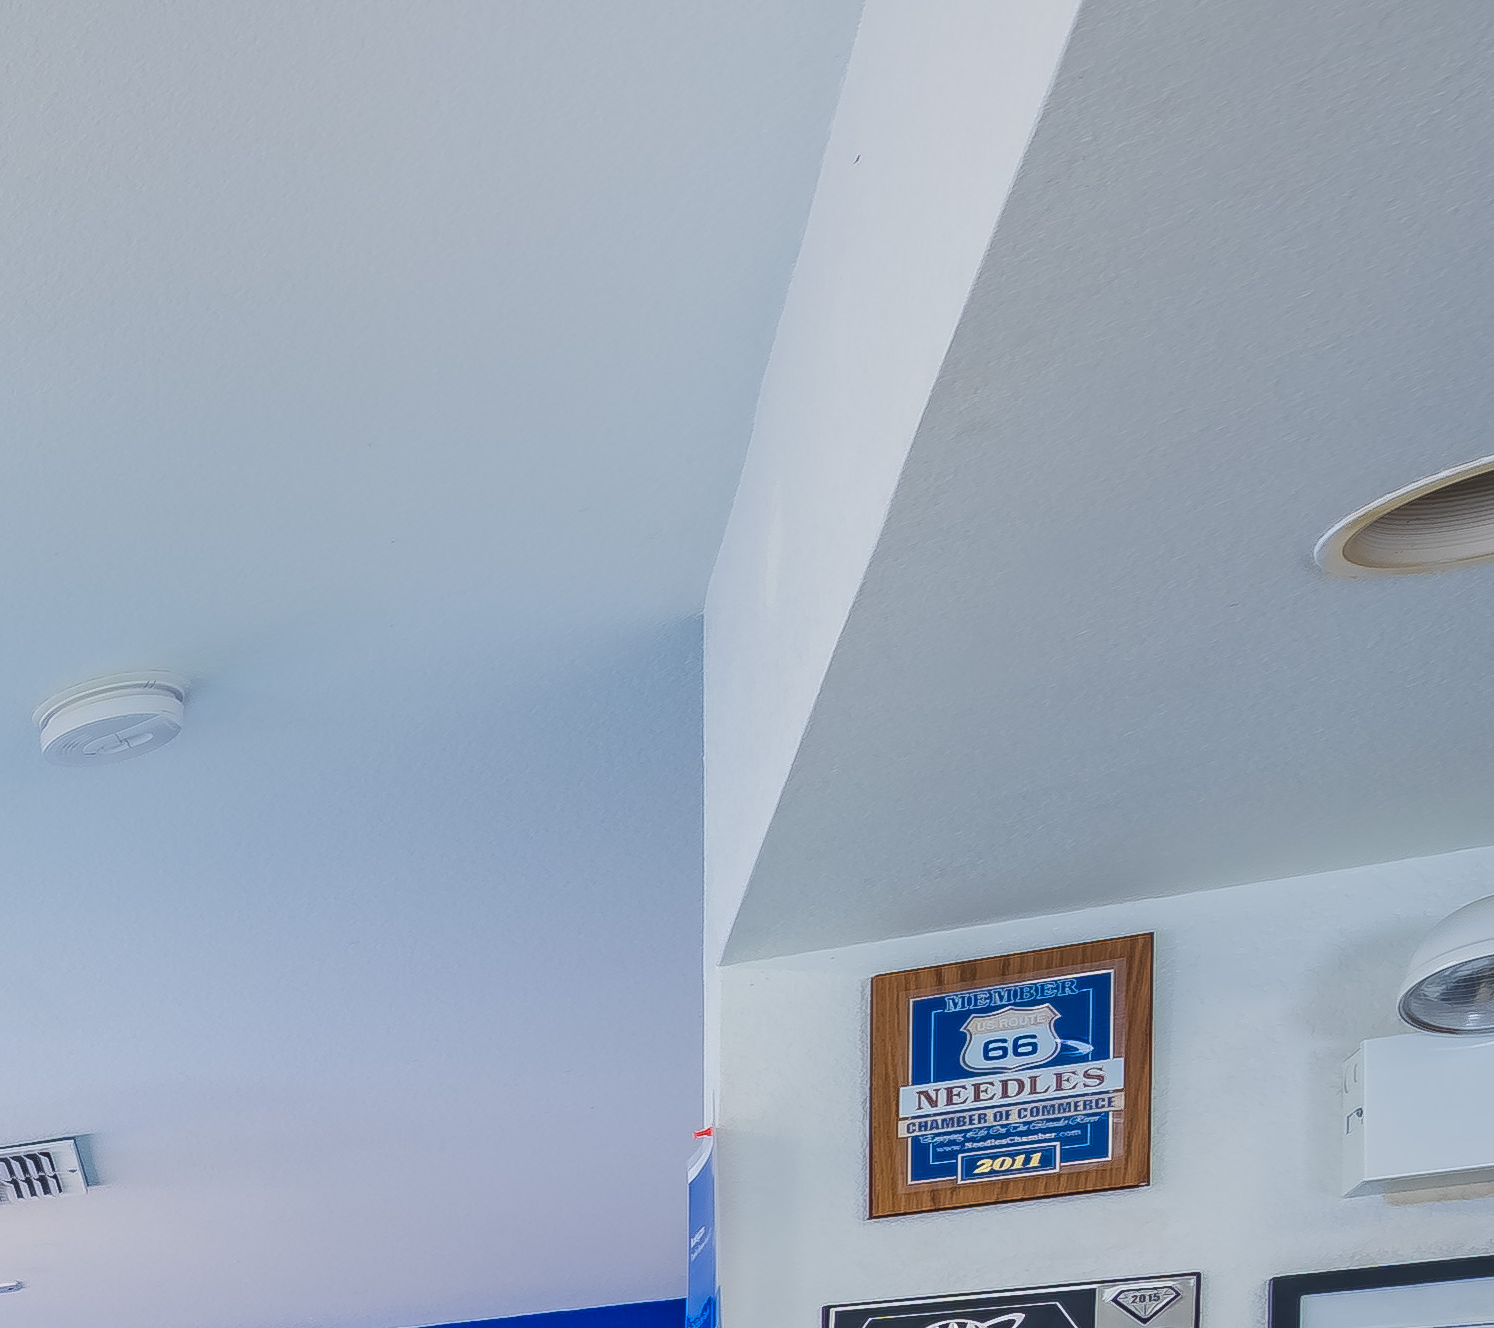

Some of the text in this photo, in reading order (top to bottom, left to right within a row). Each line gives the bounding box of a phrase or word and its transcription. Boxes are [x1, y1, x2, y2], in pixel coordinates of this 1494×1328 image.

[944, 978, 1080, 1013] MEMBER
[999, 1013, 1046, 1028] ROUTE
[982, 1034, 1038, 1062] 66
[915, 1066, 1106, 1112] NEEDLES
[906, 1095, 1116, 1135] CHAMBER OF COMMERCE
[973, 1152, 1043, 1174] 2011
[1130, 1293, 1161, 1304] 2015
